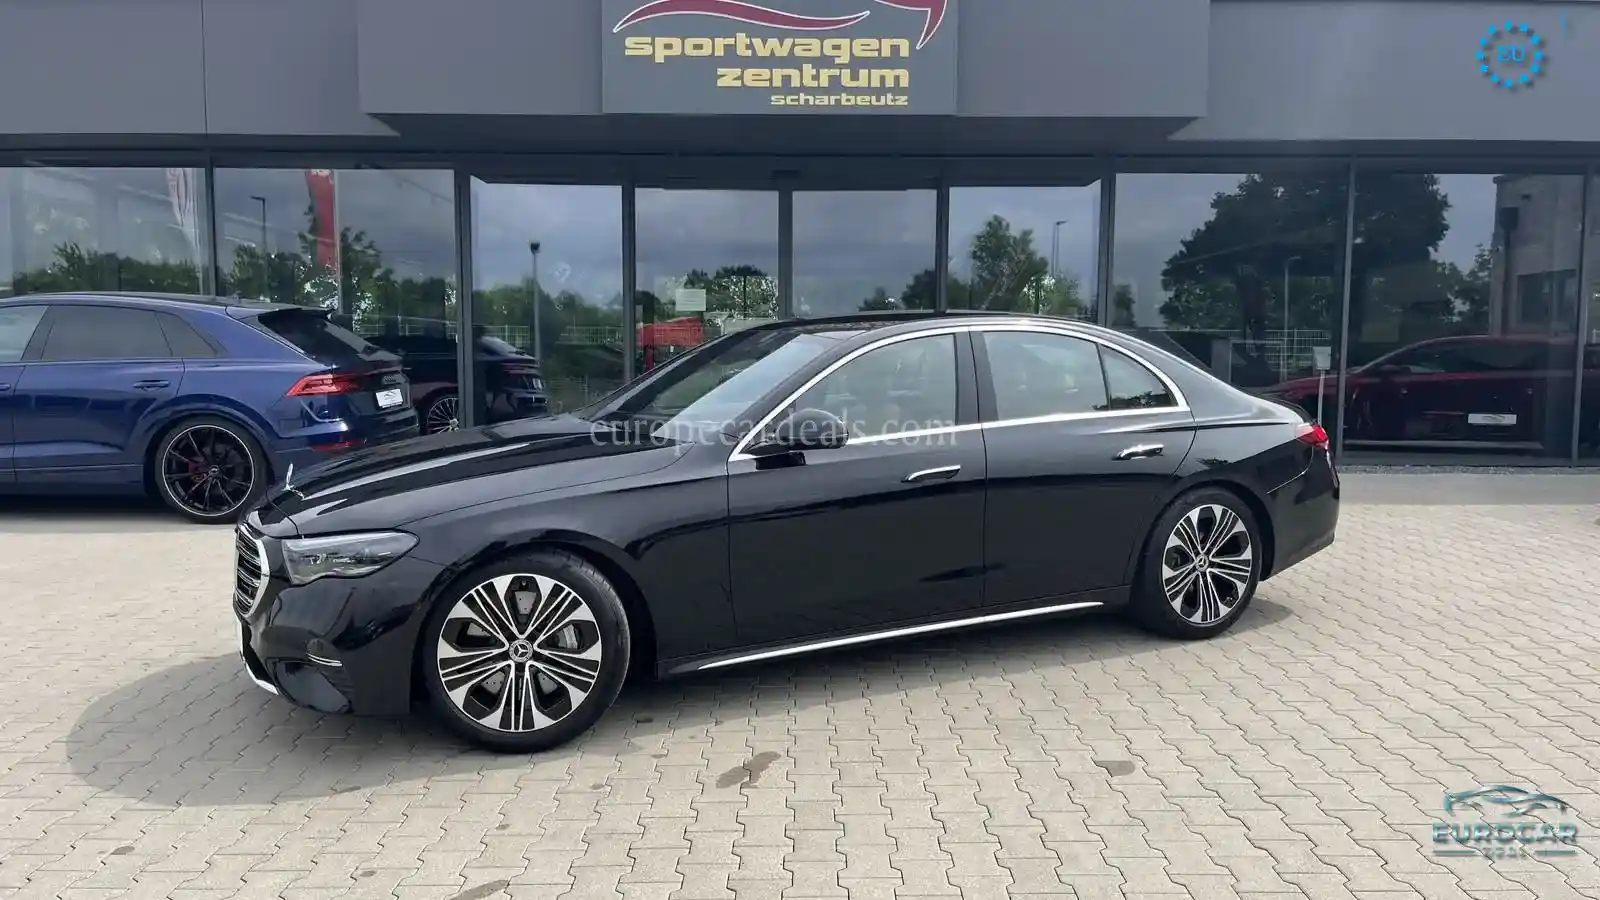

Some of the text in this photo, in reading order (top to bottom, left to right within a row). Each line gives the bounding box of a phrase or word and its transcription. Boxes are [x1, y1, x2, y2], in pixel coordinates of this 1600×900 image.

[625, 33, 910, 64] sportwagen
[716, 63, 909, 88] zentrum
[770, 93, 909, 106] scharbeutz
